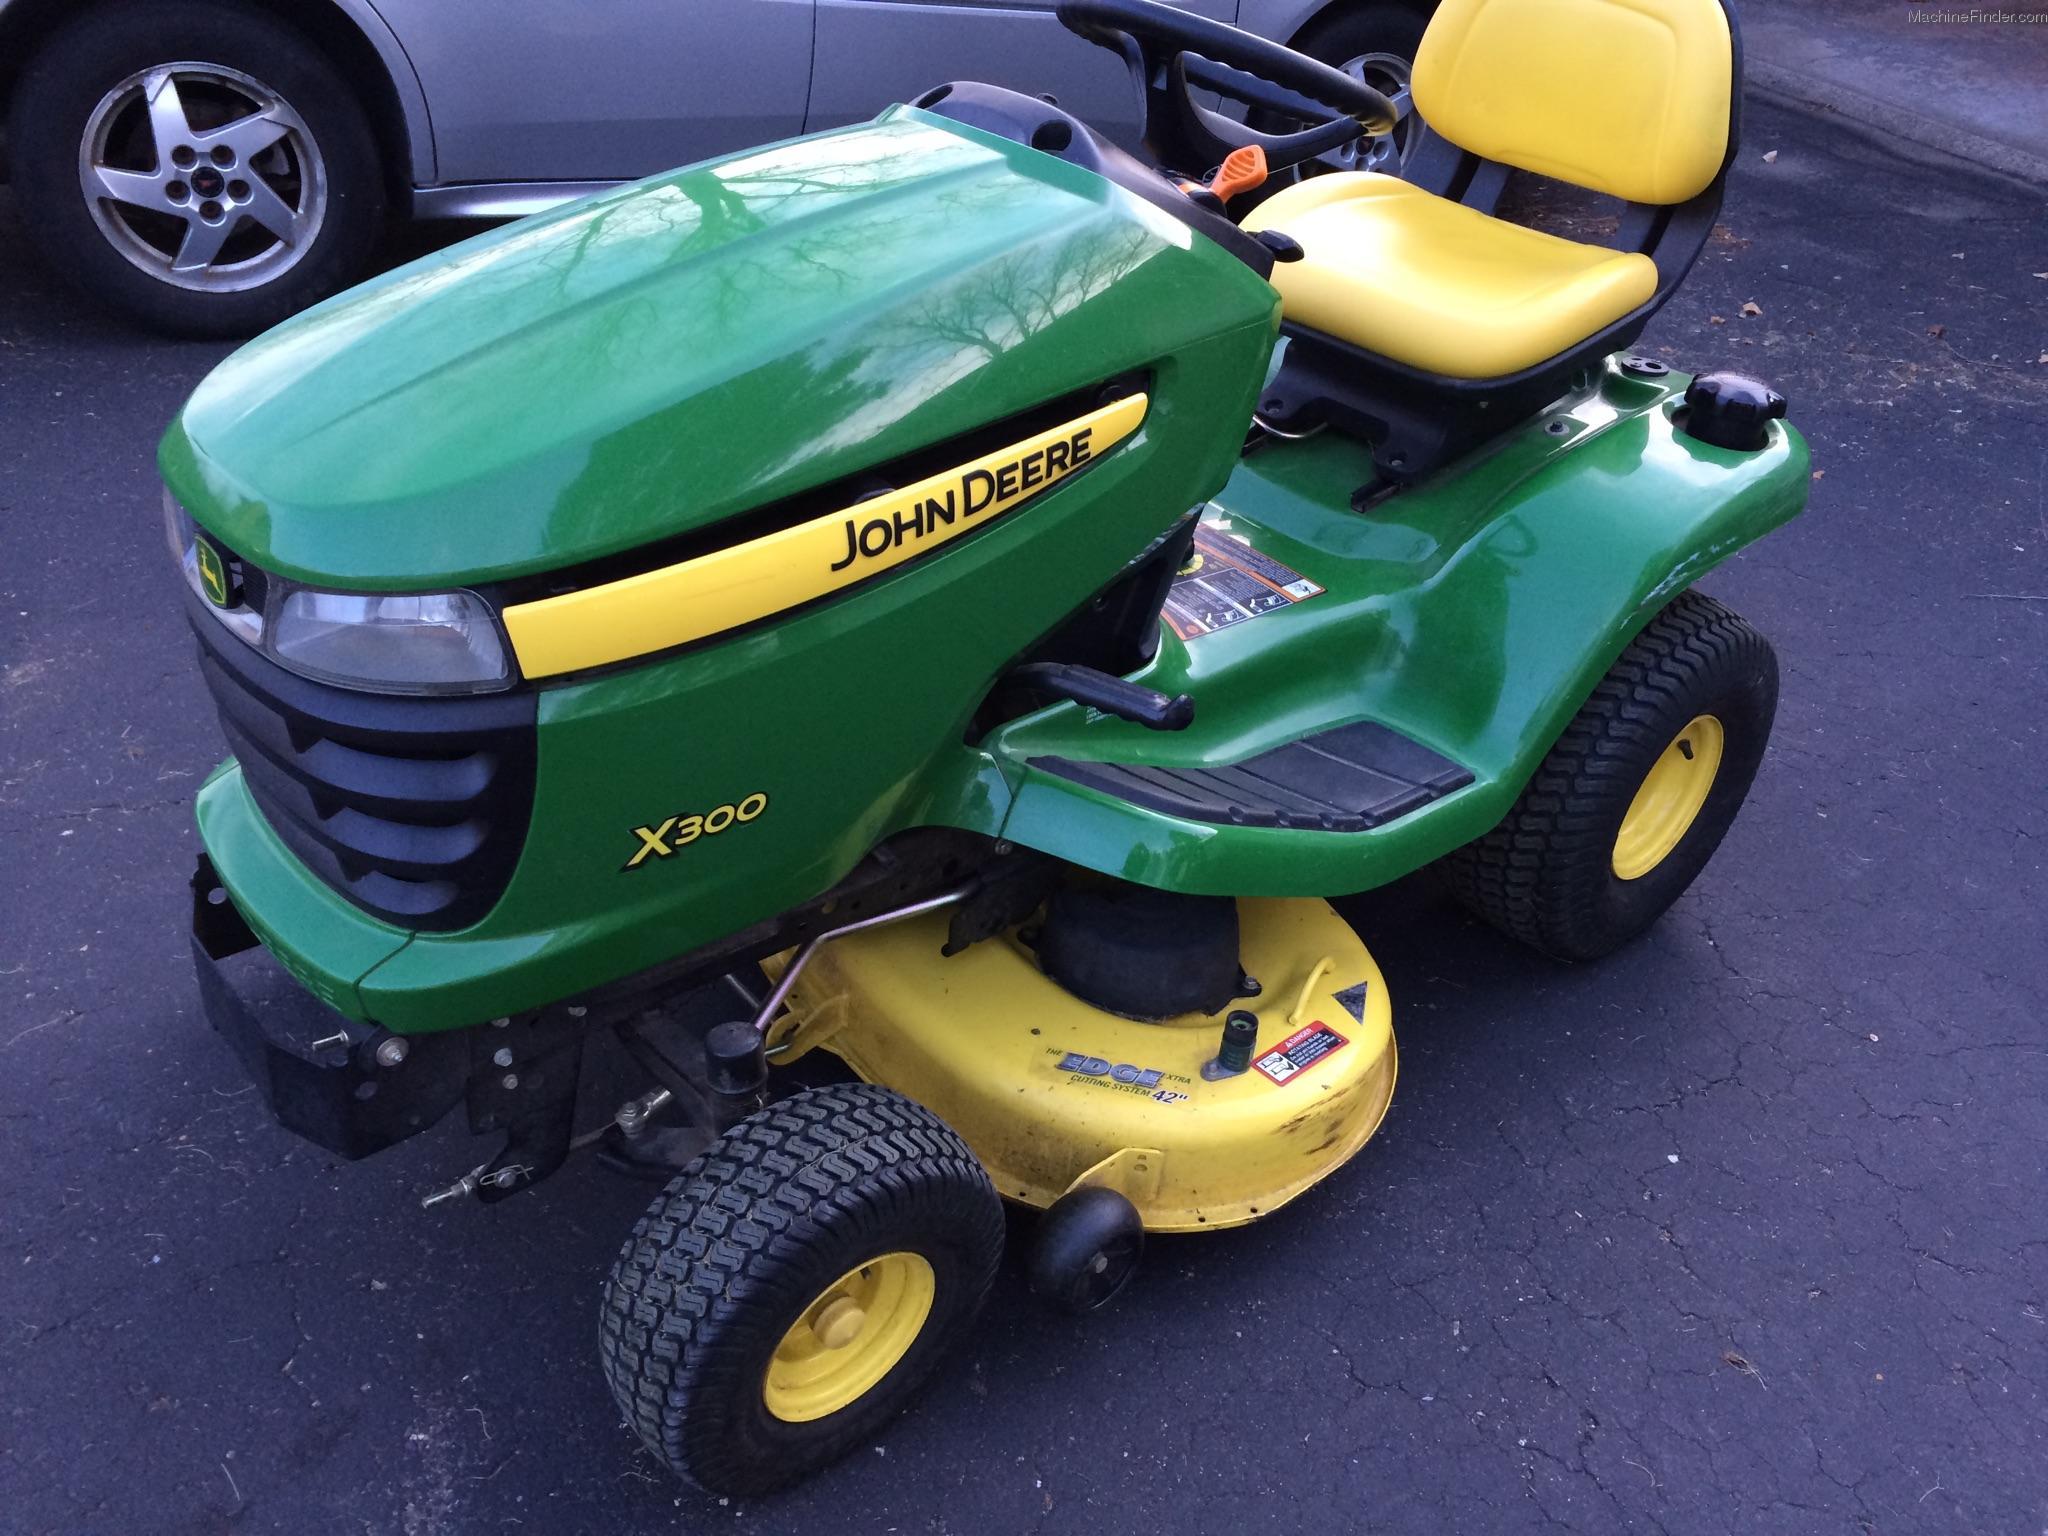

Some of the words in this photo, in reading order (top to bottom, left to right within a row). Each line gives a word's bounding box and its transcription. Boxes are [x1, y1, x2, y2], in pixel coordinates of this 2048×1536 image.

[831, 489, 955, 572] JOHN
[962, 427, 1093, 518] DEERE
[620, 790, 768, 872] X300
[1046, 1047, 1063, 1057] THE
[1055, 1052, 1165, 1088] EDGE
[1165, 1073, 1192, 1085] XTRA
[1070, 1074, 1110, 1088] CUTTING
[1111, 1083, 1151, 1097] SYSTEM
